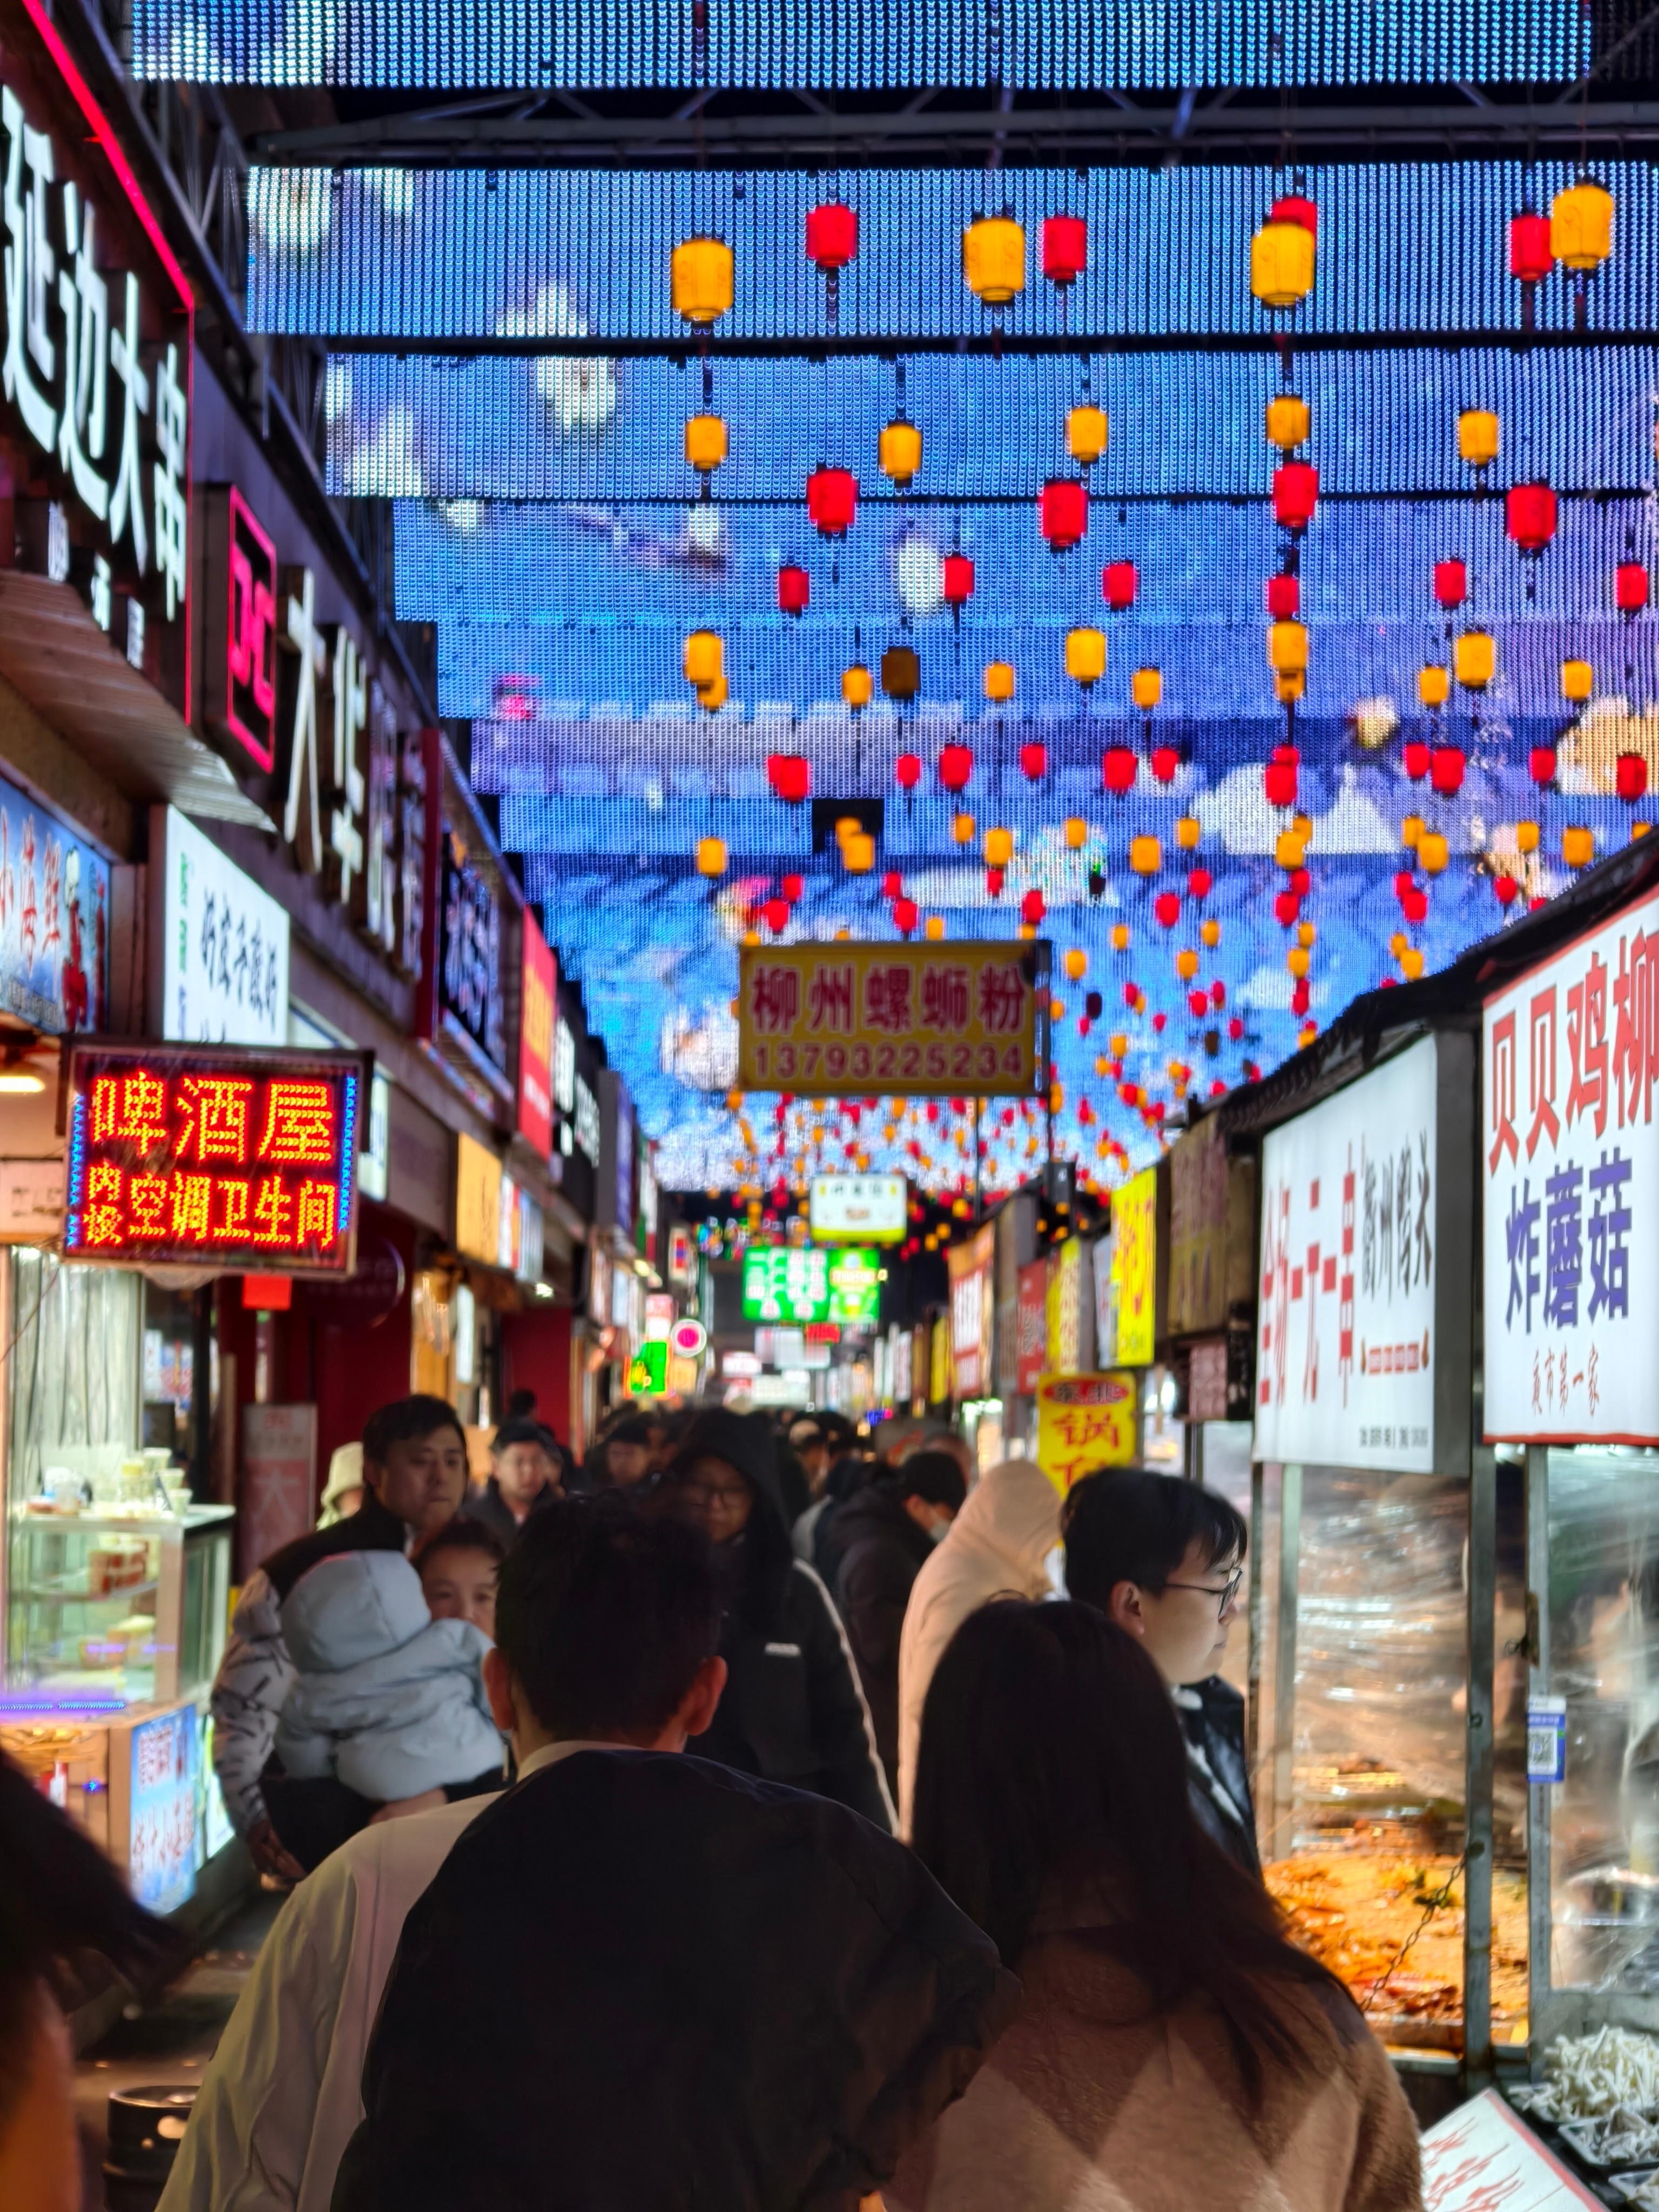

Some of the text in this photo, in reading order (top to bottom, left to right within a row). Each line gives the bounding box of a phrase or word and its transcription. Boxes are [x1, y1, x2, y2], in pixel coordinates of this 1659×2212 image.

[2, 84, 186, 622] 延边大串
[751, 962, 1026, 1035] 柳州螺蛳粉
[753, 1042, 1024, 1079] 13793225234
[1489, 925, 1659, 1177] 贝贝鸡柳
[92, 1070, 334, 1163] 啤酒屋
[128, 1169, 336, 1249] 空调卫生间
[1505, 1147, 1632, 1336] 炸蘑菇
[1532, 1342, 1601, 1420] 夜市第一家
